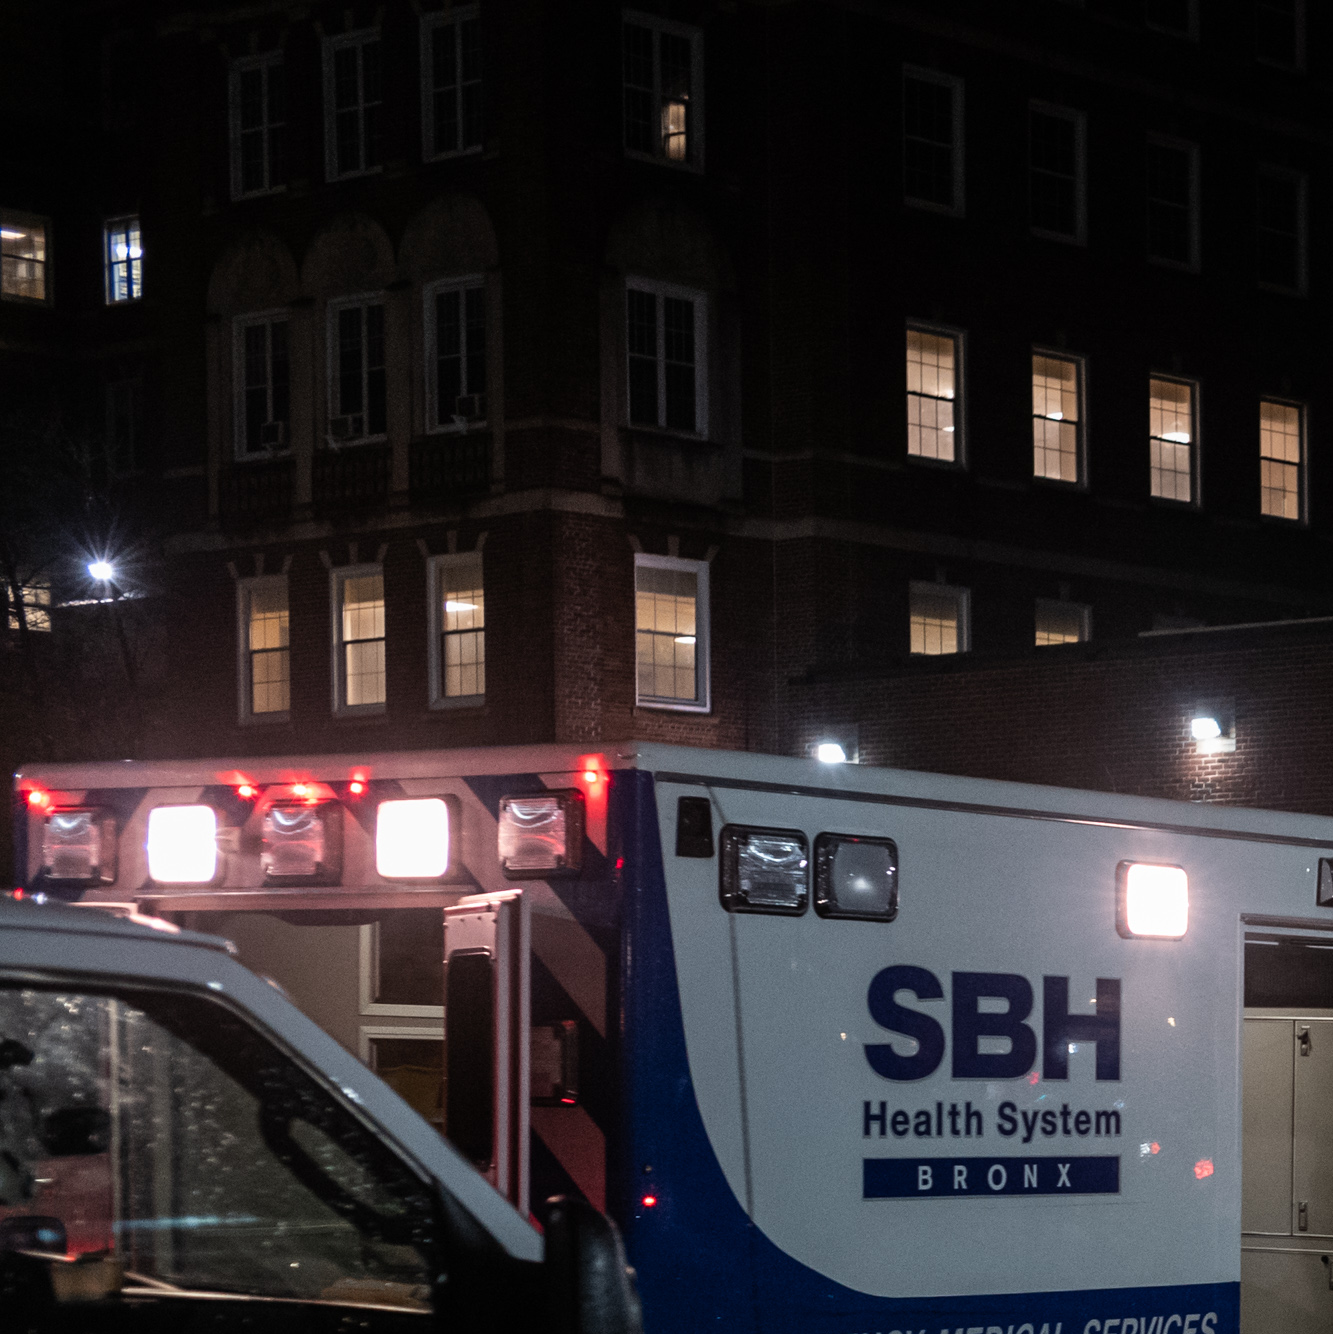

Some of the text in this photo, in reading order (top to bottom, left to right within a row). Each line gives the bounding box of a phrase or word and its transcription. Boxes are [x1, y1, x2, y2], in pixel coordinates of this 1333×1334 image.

[863, 965, 1121, 1081] SBH
[862, 1101, 1122, 1143] Health System
[918, 1163, 1072, 1190] BRONX
